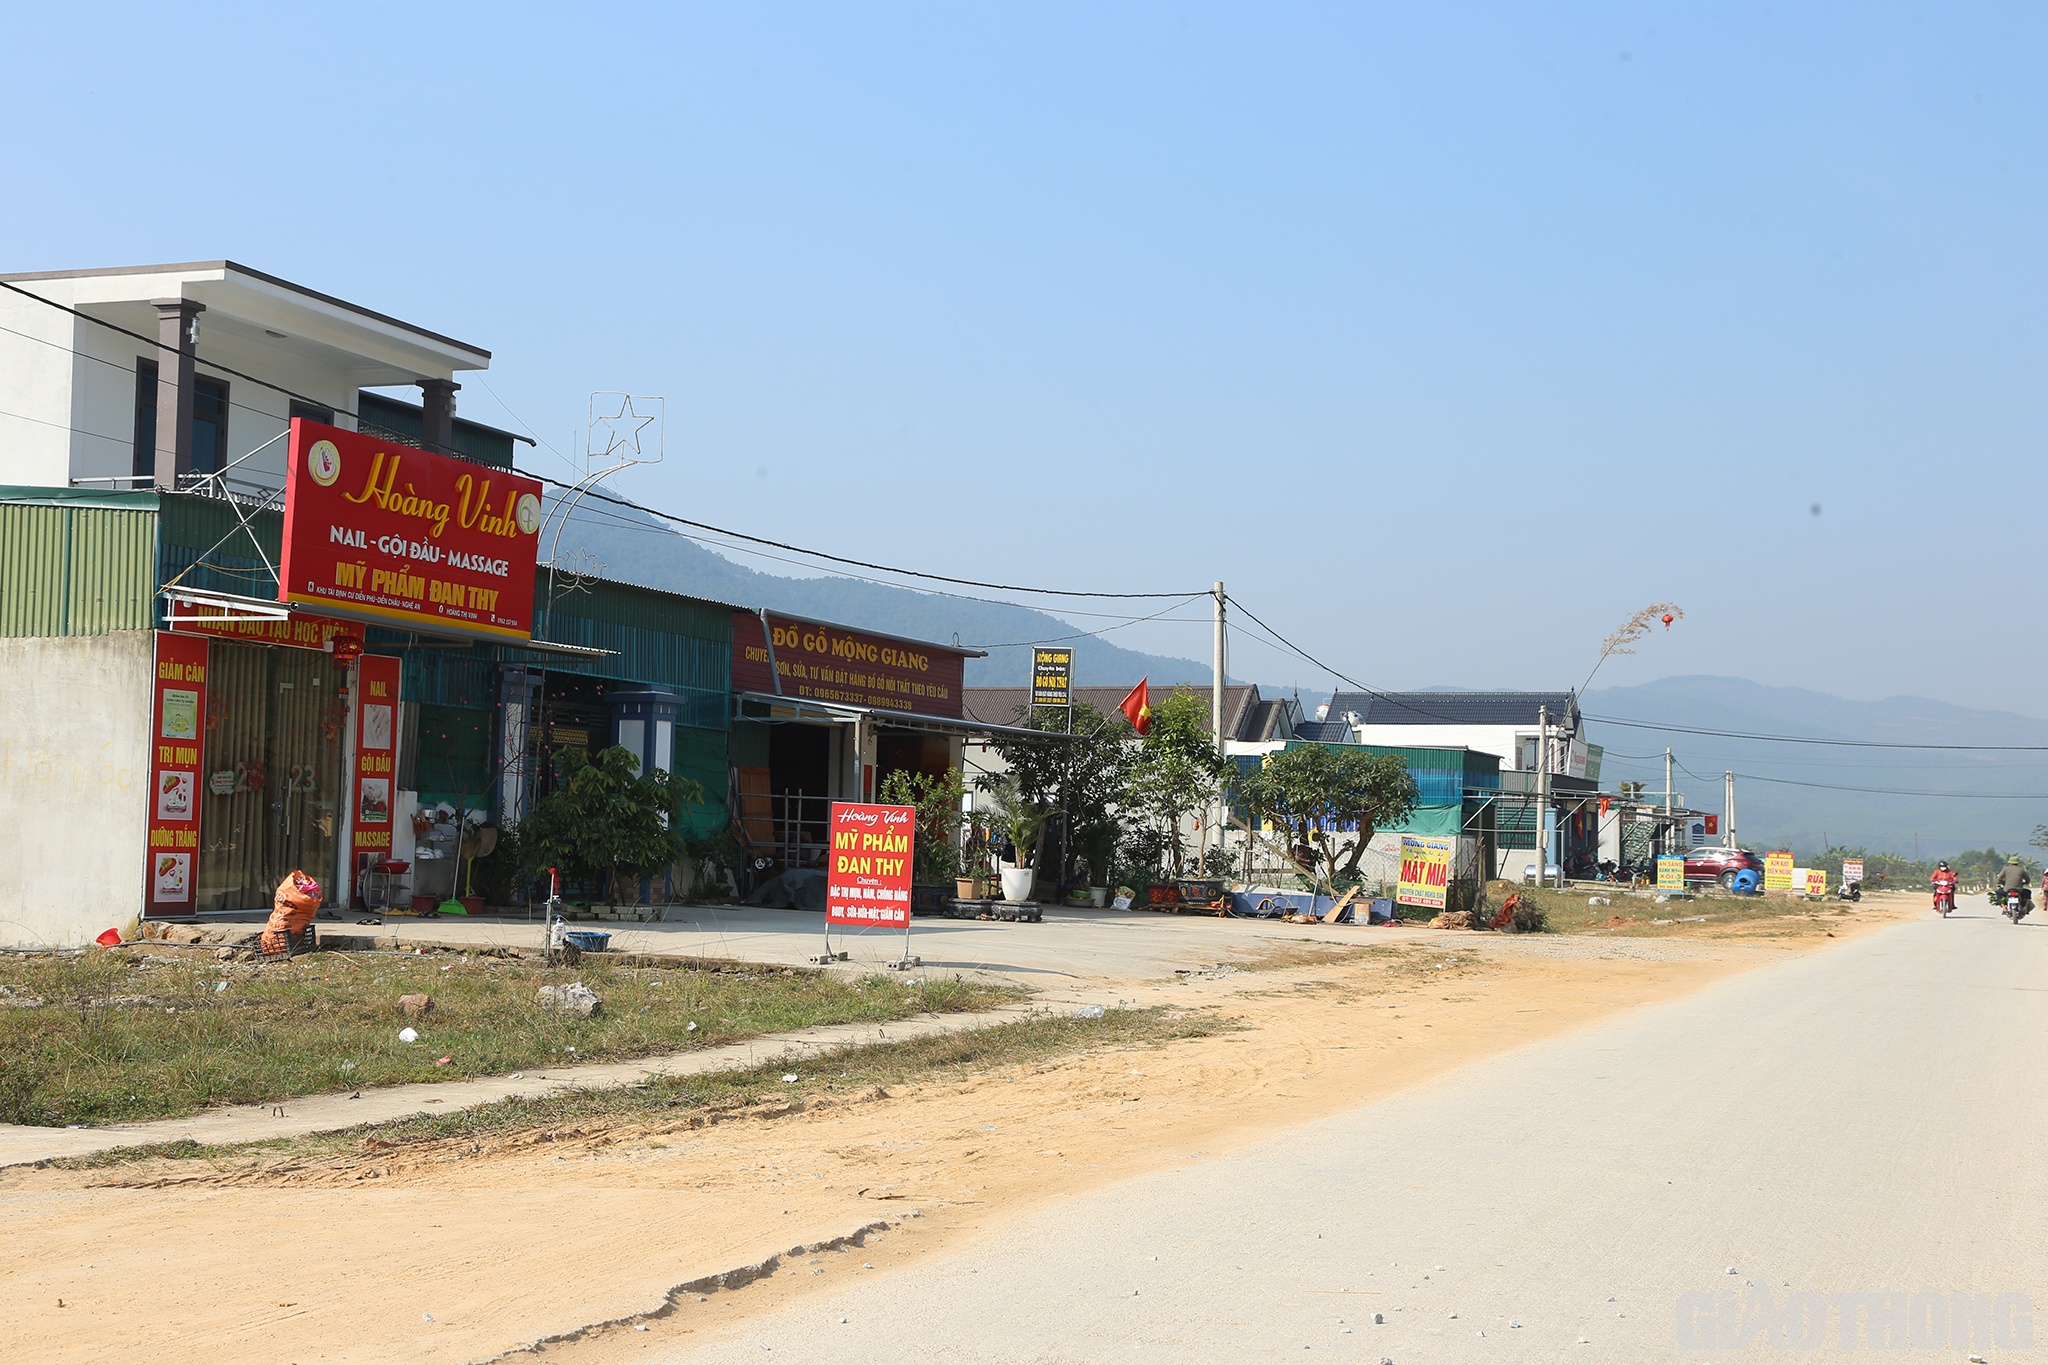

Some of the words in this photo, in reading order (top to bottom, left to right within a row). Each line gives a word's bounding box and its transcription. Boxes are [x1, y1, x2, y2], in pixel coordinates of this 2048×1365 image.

[341, 453, 450, 538] Hoàng
[454, 473, 517, 538] Vinh
[330, 525, 367, 549] NAIL
[378, 533, 407, 559] GỘI
[409, 536, 440, 564] ĐẦU
[447, 550, 509, 577] MASSAGE
[316, 586, 327, 595] KHU
[335, 560, 367, 591] MỸ
[371, 564, 425, 601] PHẨM
[429, 579, 465, 607] ĐAN
[467, 586, 499, 613] THY
[446, 608, 460, 616] HOÀNG
[294, 620, 319, 647] HỌC
[773, 622, 799, 649] ĐỒ
[803, 627, 828, 654] GỖ
[832, 636, 878, 663] MỘNG
[881, 649, 929, 672] GIANG
[159, 657, 183, 681] GIẢM
[185, 662, 205, 684] CÂN
[745, 645, 770, 663] CHUYÊ
[810, 665, 820, 680] TƯ
[821, 664, 834, 683] VẤN
[835, 668, 849, 688] ĐẶT
[849, 669, 866, 688] HÀNG
[896, 677, 911, 694] THẤT
[912, 683, 925, 697] THEO
[926, 682, 936, 698] YÊU
[370, 681, 387, 697] NAIL
[159, 746, 174, 767] TRỊ
[176, 747, 197, 769] MỤN
[361, 755, 374, 774] GỘI
[837, 808, 879, 826] Hoàng
[881, 810, 909, 825] Vinh
[175, 827, 197, 848] TRẮNG
[355, 831, 390, 847] MASSAGE
[835, 828, 859, 850] MỸ
[862, 825, 908, 853] PHẨM
[1427, 842, 1448, 851] GIANG
[837, 855, 871, 875] ĐAN
[875, 858, 904, 877] THY
[1400, 855, 1426, 887] MẬT
[1425, 858, 1447, 887] MÍA
[1807, 872, 1824, 884] RỬA
[1810, 886, 1821, 894] XE
